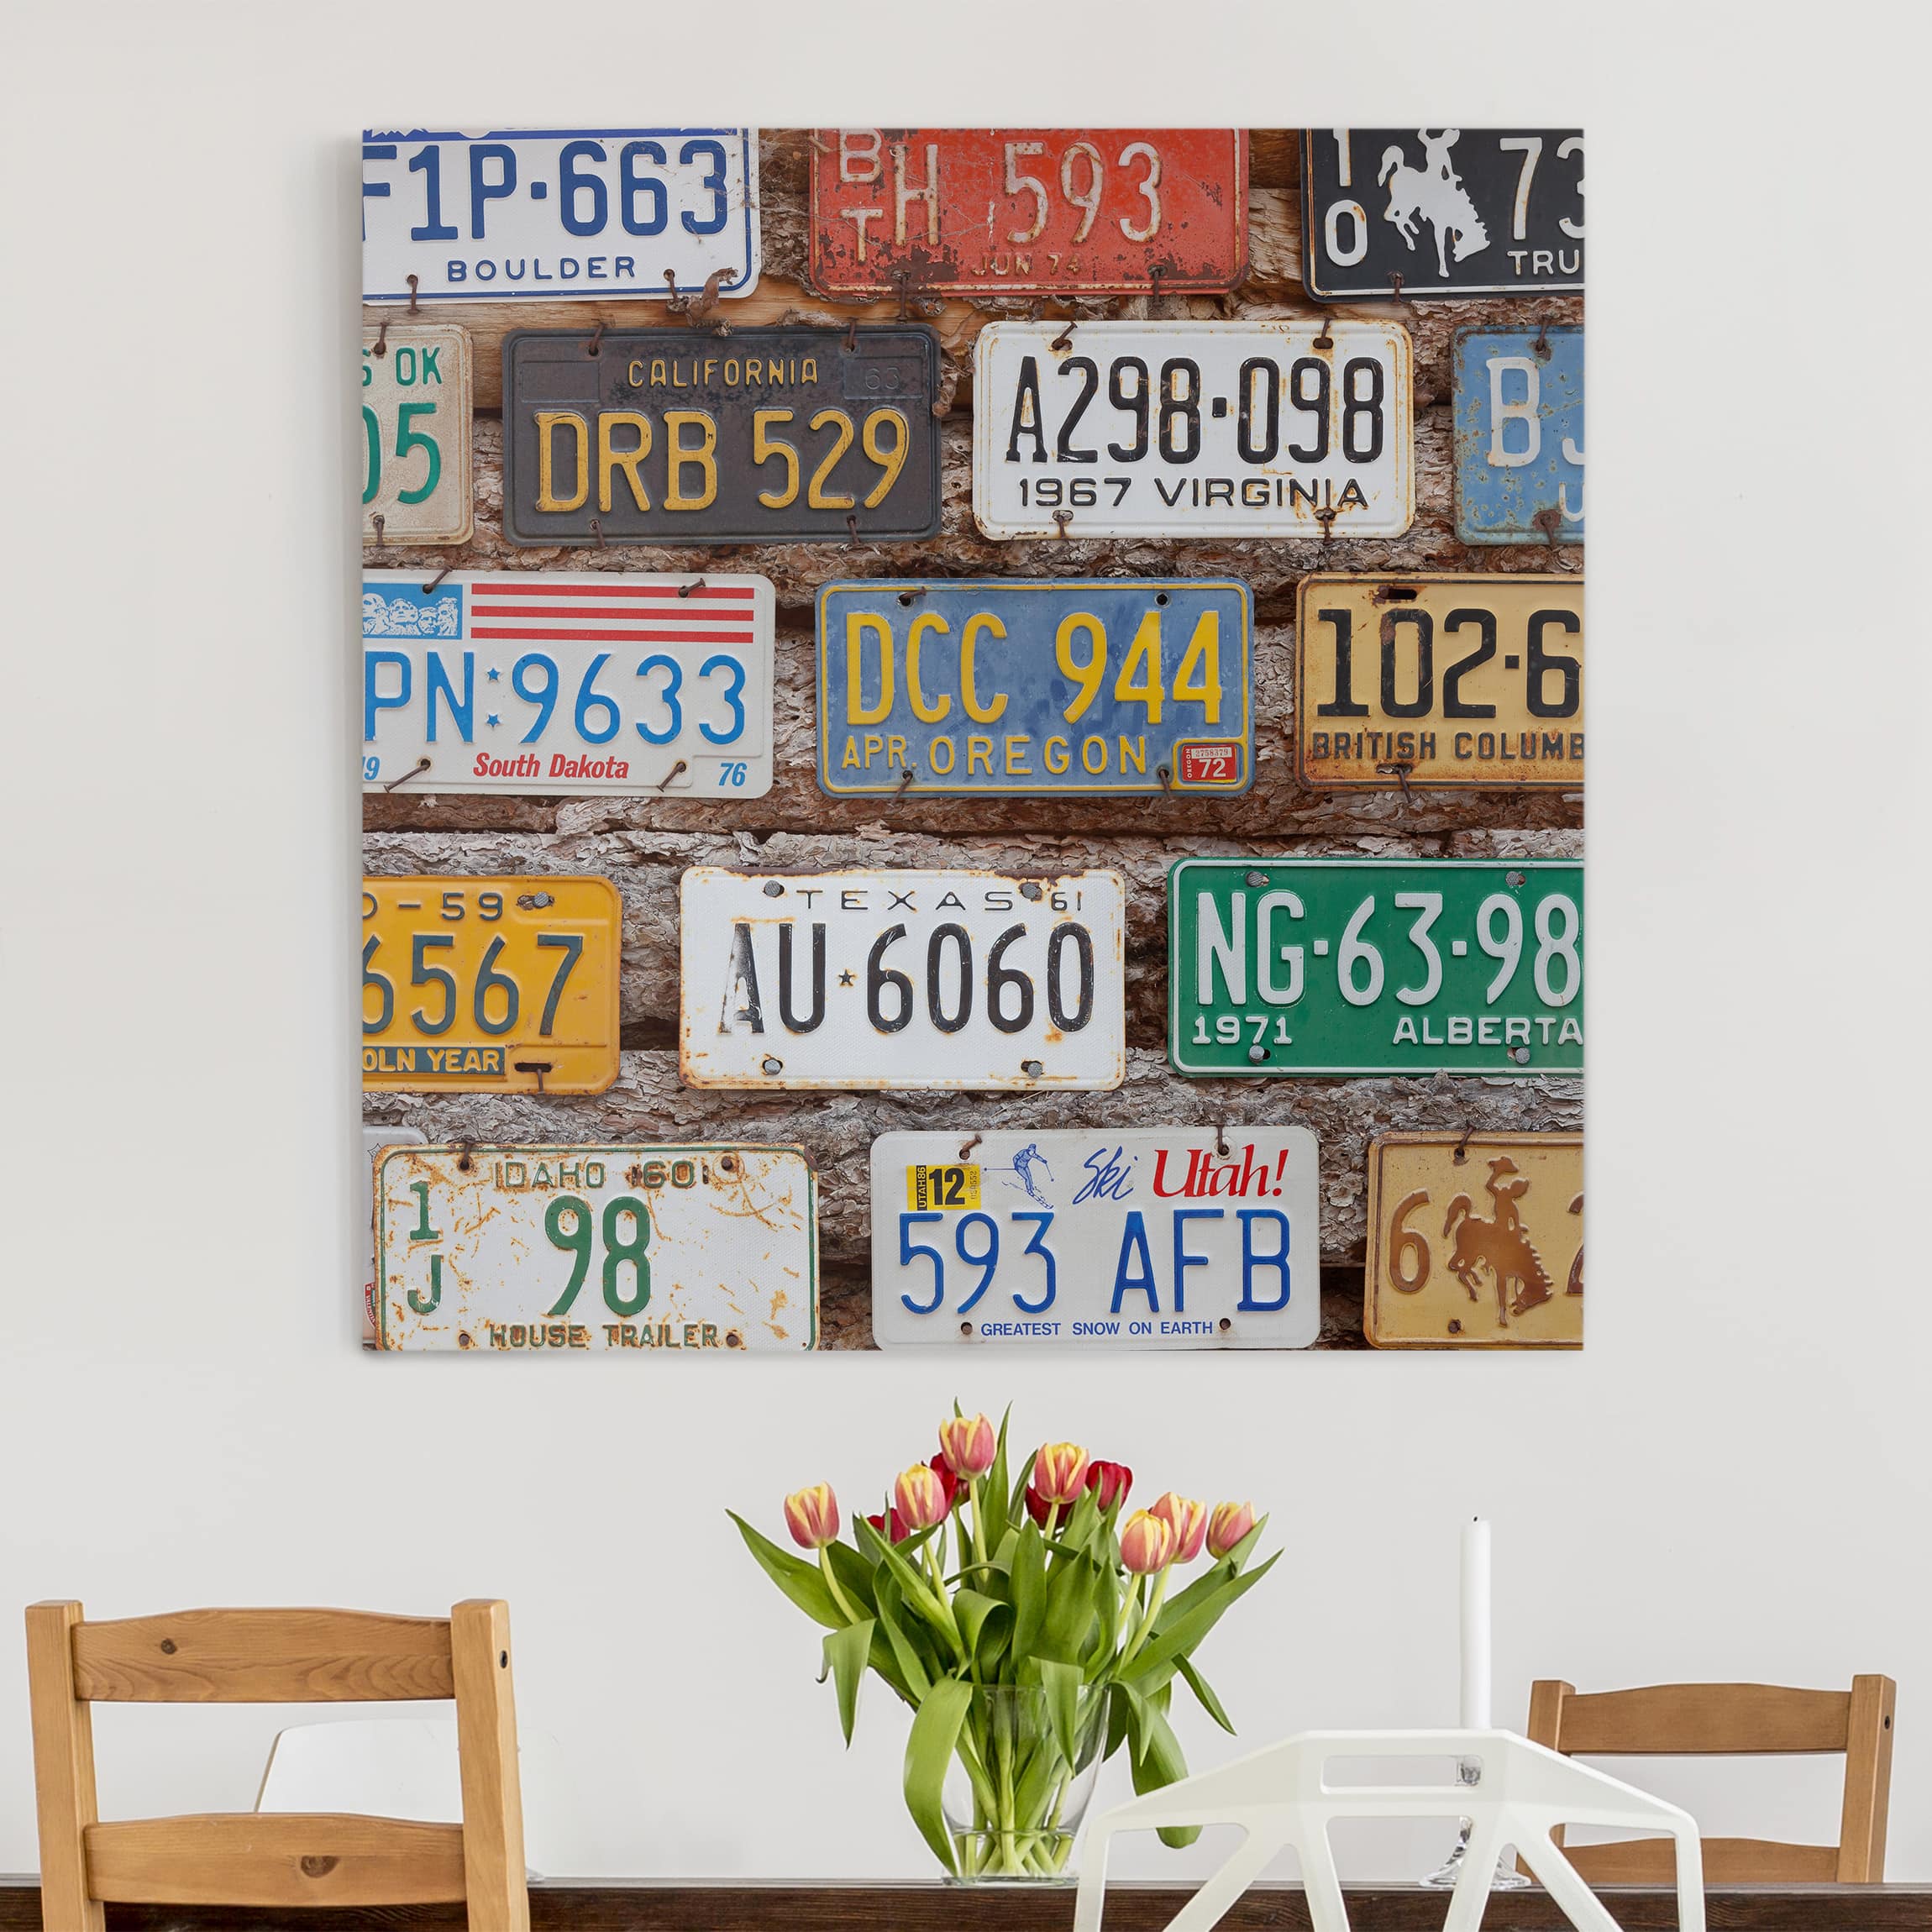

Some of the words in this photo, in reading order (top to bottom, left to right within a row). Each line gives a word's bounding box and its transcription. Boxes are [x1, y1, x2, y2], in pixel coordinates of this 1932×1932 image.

[1005, 141, 1162, 244] 593
[448, 256, 635, 281] BOULDER
[971, 254, 1032, 276] JUN
[1507, 249, 1580, 276] TRU
[396, 347, 442, 386] OK
[628, 358, 818, 388] CALIFORNIA
[535, 411, 717, 512] DRB
[753, 409, 910, 510] 529
[1019, 478, 1131, 507] 1967
[1154, 478, 1368, 507] VIRGINIA
[846, 612, 1008, 726] DCC
[1055, 611, 1223, 725] 944
[842, 736, 917, 769] APR.
[929, 736, 1146, 775] OREGON
[1313, 732, 1436, 759] BRITISH
[1455, 732, 1584, 760] COLUMB
[473, 752, 539, 778] South
[549, 753, 629, 780] Dakota
[718, 763, 746, 786] 76
[1199, 758, 1226, 778] 72
[796, 890, 1013, 911] TEXAS
[1051, 891, 1083, 911] 61
[1192, 1016, 1293, 1045] 1971
[1393, 1017, 1583, 1045] ALBERTA
[428, 1048, 500, 1072] YEAR
[496, 1161, 605, 1189] IDAHO
[928, 1167, 965, 1205] 12
[1072, 1146, 1139, 1205] Ski
[1153, 1143, 1289, 1198] Utah!
[544, 1194, 650, 1316] 98
[1389, 1188, 1430, 1294] 6
[900, 1211, 1057, 1315] 593
[1110, 1209, 1291, 1314] AFB
[490, 1323, 586, 1347] HOUSE
[602, 1323, 718, 1347] TRAILER
[980, 1322, 1061, 1336] GREATEST
[1072, 1321, 1120, 1336] SNOW
[1128, 1321, 1152, 1335] ON
[1161, 1321, 1213, 1335] EARTH
